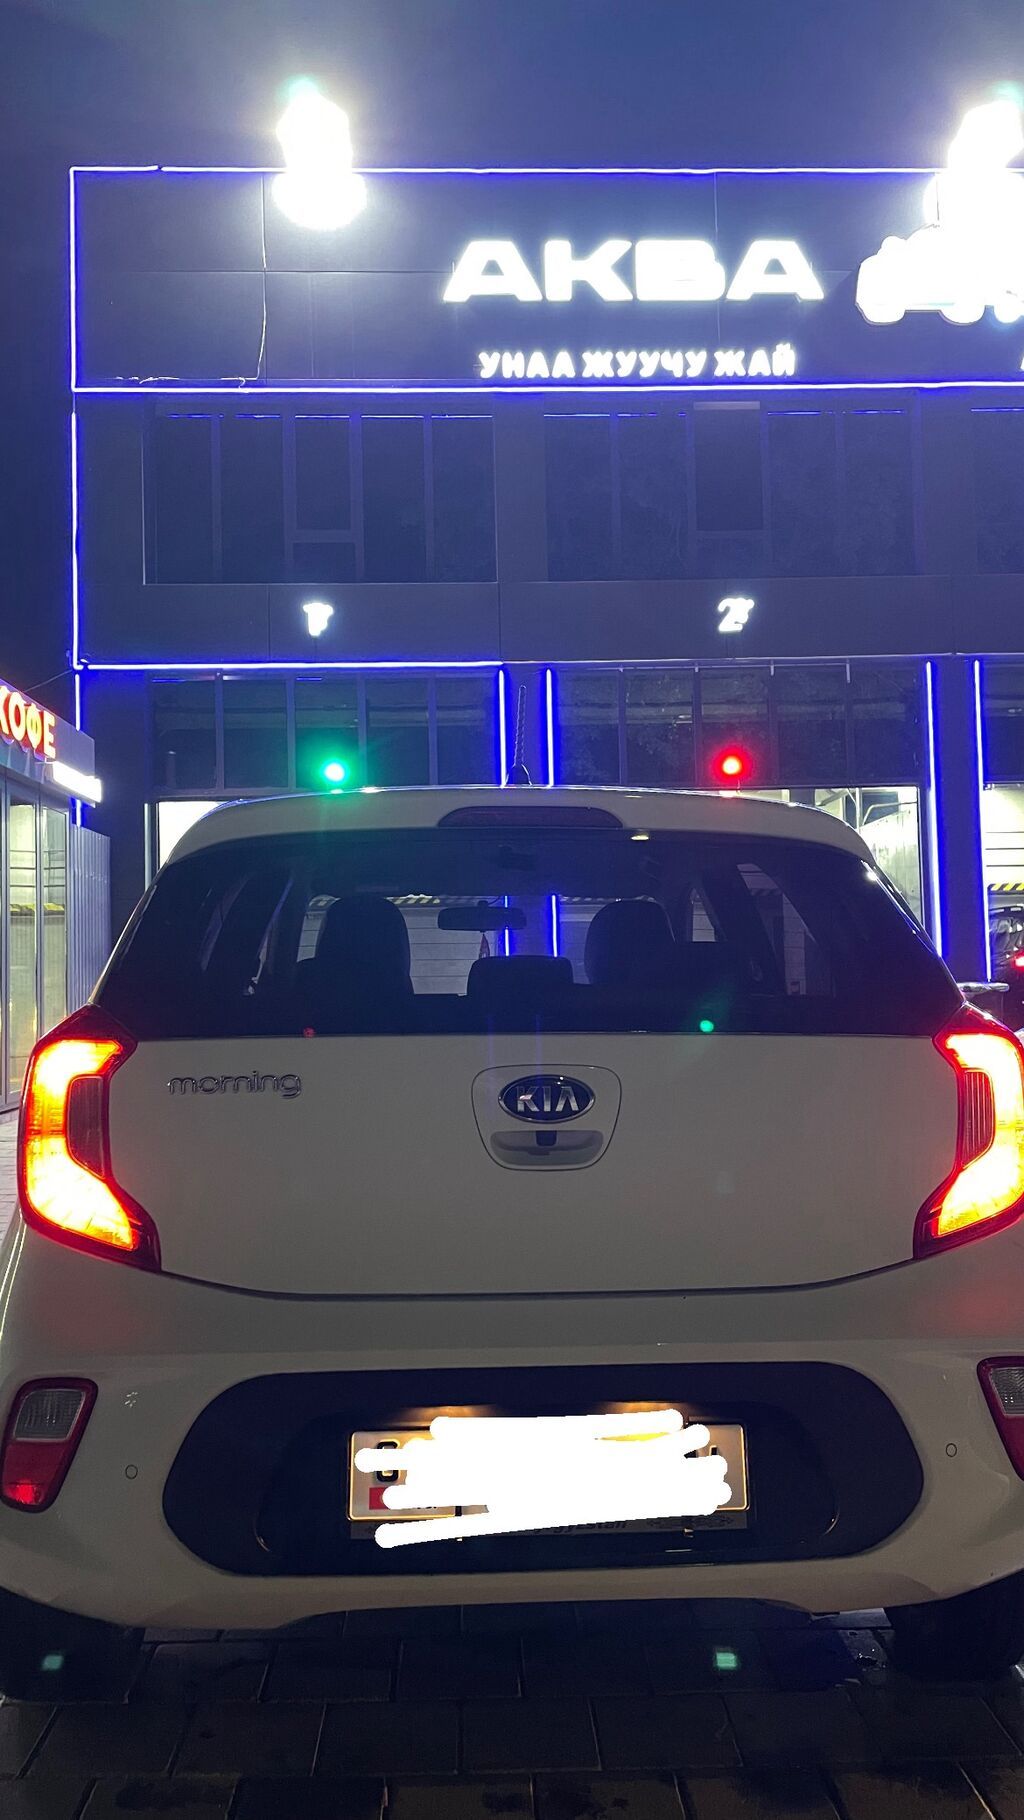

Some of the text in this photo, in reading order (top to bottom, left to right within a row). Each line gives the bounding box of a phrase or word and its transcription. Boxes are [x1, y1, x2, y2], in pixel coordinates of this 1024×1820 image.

[442, 239, 825, 302] АКВА
[478, 343, 796, 379] УНАА ЖУУЧУ ЖАЙ
[167, 1070, 302, 1100] morning
[516, 1085, 580, 1112] KIA
